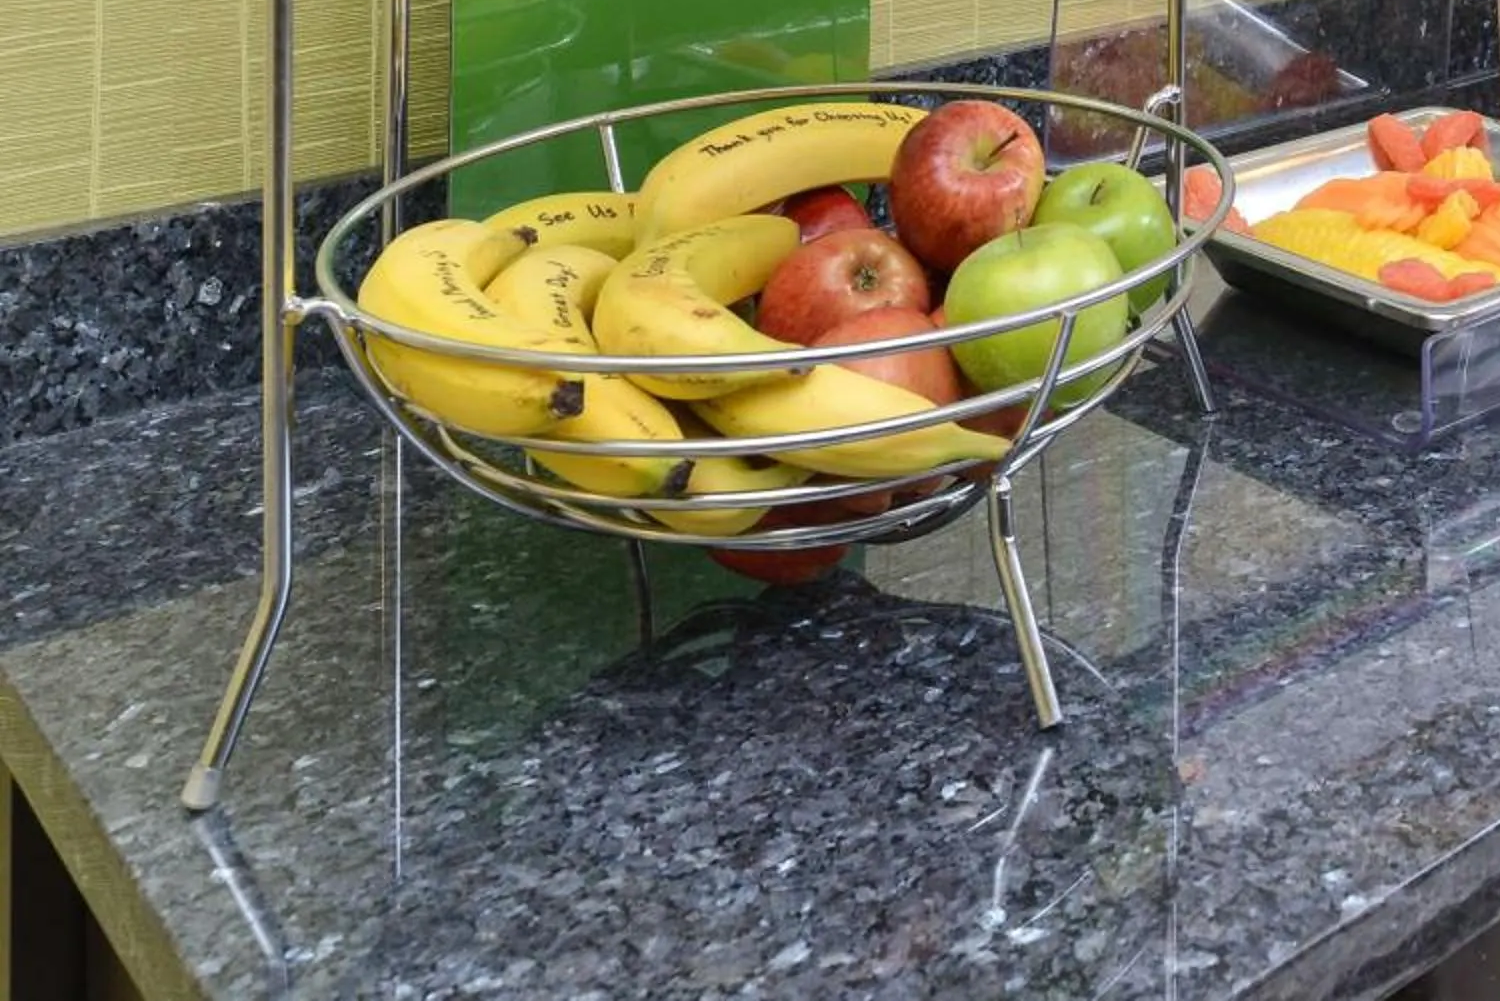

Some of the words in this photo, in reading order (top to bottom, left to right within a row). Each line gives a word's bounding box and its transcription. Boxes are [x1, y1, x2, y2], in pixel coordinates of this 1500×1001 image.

[699, 134, 752, 157] Thank
[757, 124, 786, 142] you
[785, 115, 810, 127] for
[537, 211, 576, 227] See
